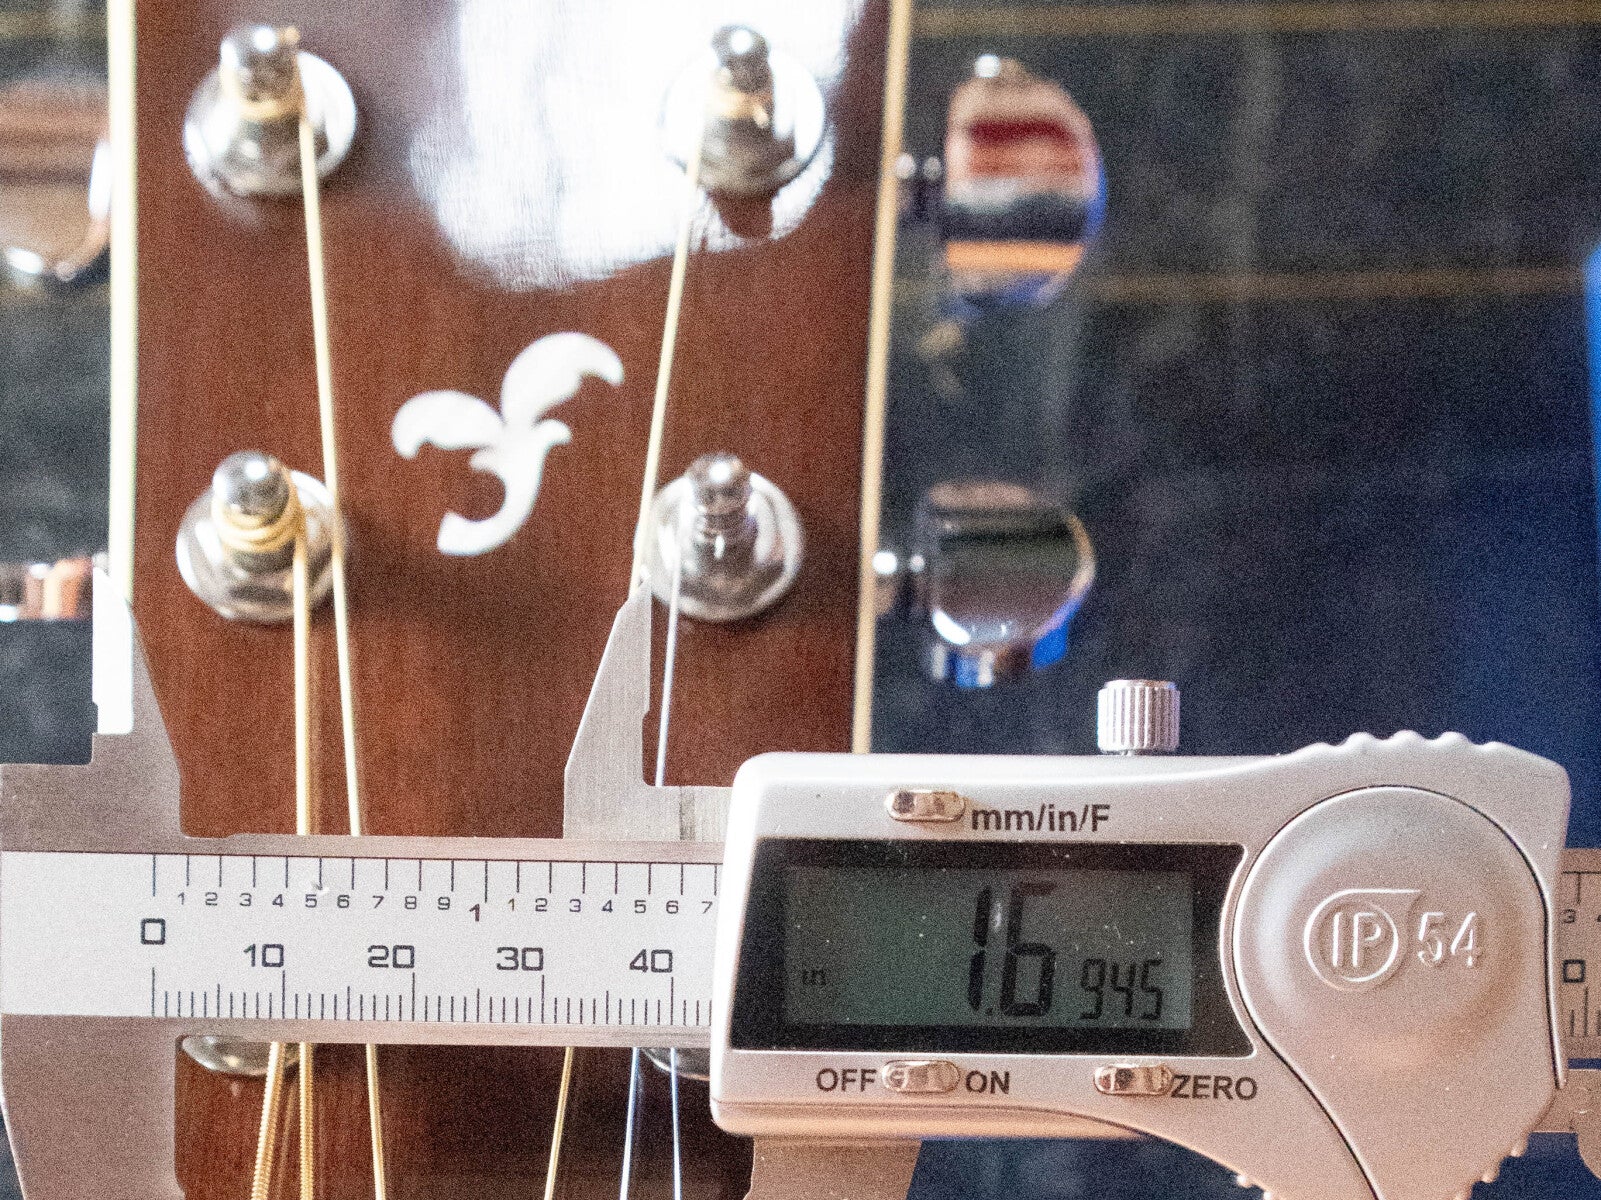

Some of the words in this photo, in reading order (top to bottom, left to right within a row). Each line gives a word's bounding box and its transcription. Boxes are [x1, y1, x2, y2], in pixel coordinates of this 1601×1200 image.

[971, 803, 1111, 833] mm/in/F
[177, 891, 186, 905] 1
[205, 891, 218, 906] 2
[239, 893, 252, 907] 3
[272, 894, 284, 908] 4
[305, 894, 318, 909] 5
[337, 895, 350, 909] 6
[372, 895, 385, 909] 7
[404, 896, 417, 909] 8
[437, 896, 450, 910] 9
[469, 903, 481, 922] 1
[507, 898, 515, 911] 1
[535, 898, 548, 912] 2
[569, 898, 582, 913] 3
[602, 900, 613, 913] 4
[634, 900, 647, 914] 5
[666, 900, 679, 914] 6
[701, 901, 713, 914] 7
[1561, 909, 1576, 923] 3
[140, 918, 166, 945] 0
[243, 943, 284, 967] 10
[367, 945, 415, 969] 20
[496, 947, 544, 971] 30
[629, 949, 673, 973] 40
[1332, 911, 1382, 968] IP
[1417, 911, 1479, 968] 54
[816, 1068, 877, 1093] OFF
[965, 1070, 1010, 1095] ON
[1171, 1073, 1258, 1101] ZERO
